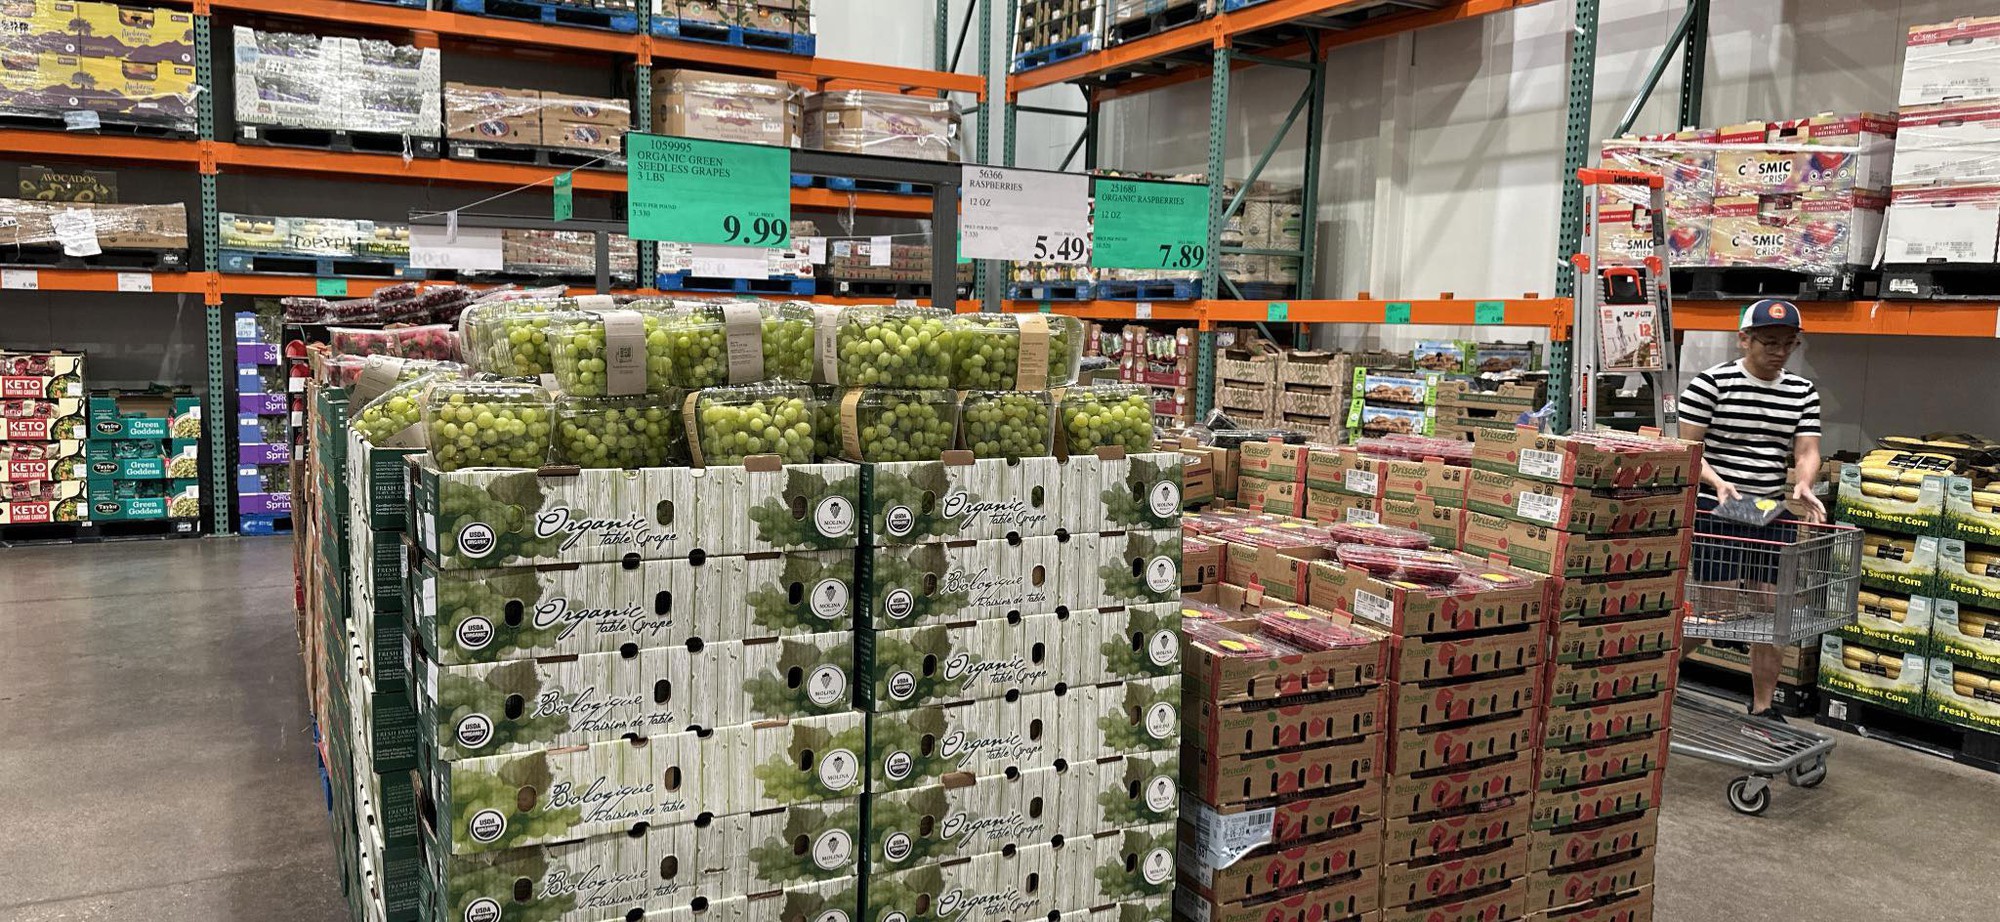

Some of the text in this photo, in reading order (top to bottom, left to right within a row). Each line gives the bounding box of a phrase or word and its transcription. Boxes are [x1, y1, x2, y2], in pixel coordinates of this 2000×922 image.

[650, 139, 692, 152] 1059995
[637, 151, 723, 166] ORGANIC GREEN
[40, 172, 97, 184] AVOCADOS
[637, 162, 731, 178] SEEDLESS GRAPES
[638, 172, 665, 182] 3 LBS
[979, 170, 1003, 180] 56366
[969, 180, 1023, 192] RASPBERRIES
[1763, 174, 1788, 184] CRISP
[1110, 183, 1137, 193] 251680
[969, 198, 991, 207] 12 OZ
[1102, 194, 1185, 205] ORGANIC RASPBERRIES
[724, 215, 788, 246] 9.99
[1034, 235, 1085, 261] 5.49
[1159, 244, 1204, 268] 7.89
[1639, 324, 1651, 337] 12
[5, 380, 40, 389] KETO
[10, 422, 45, 431] KETO
[130, 428, 164, 436] Goddess
[1480, 428, 1520, 442] Driscoll's
[11, 463, 46, 472] KETO
[126, 468, 160, 476] Goddess
[1473, 469, 1515, 487] Driscoll's
[12, 505, 47, 514] KETO
[128, 507, 162, 515] Goddess
[267, 501, 291, 510] Sprin
[945, 492, 1023, 530] Organic
[1016, 511, 1046, 528] Grape
[1848, 507, 1929, 528] Fresh Sweet Corn
[538, 508, 648, 550] Organic
[1958, 523, 1986, 534] Fresh
[636, 529, 678, 550] Grape
[1867, 570, 1922, 587] Sweet Corn
[940, 568, 1023, 607] Biologique
[1950, 583, 2000, 600] Fresh Swe
[978, 597, 1011, 606] Raisins
[1014, 595, 1023, 604] de
[535, 598, 644, 640] Organic
[632, 618, 673, 636] Grape
[1844, 625, 1915, 646] esh Sweet Corn
[1945, 645, 2000, 663] Fresh Swee
[947, 654, 1024, 690] Organic
[1016, 668, 1048, 685] Grape
[1828, 676, 1908, 704] Fresh Sweet Corn
[530, 687, 642, 733] Biologique
[1938, 704, 2000, 726] Fresh Sweet
[581, 720, 626, 732] Raisins
[631, 715, 643, 726] de
[942, 731, 1020, 768] Organic
[1013, 743, 1043, 760] Grape
[544, 776, 654, 823] Biologique
[594, 809, 639, 822] Raisins
[642, 804, 655, 815] de
[944, 811, 1021, 848] Organic
[1014, 822, 1044, 839] Grape
[538, 864, 648, 909] Biologique
[588, 895, 633, 908] Raisins
[636, 889, 649, 900] de
[939, 887, 1017, 922] Organic
